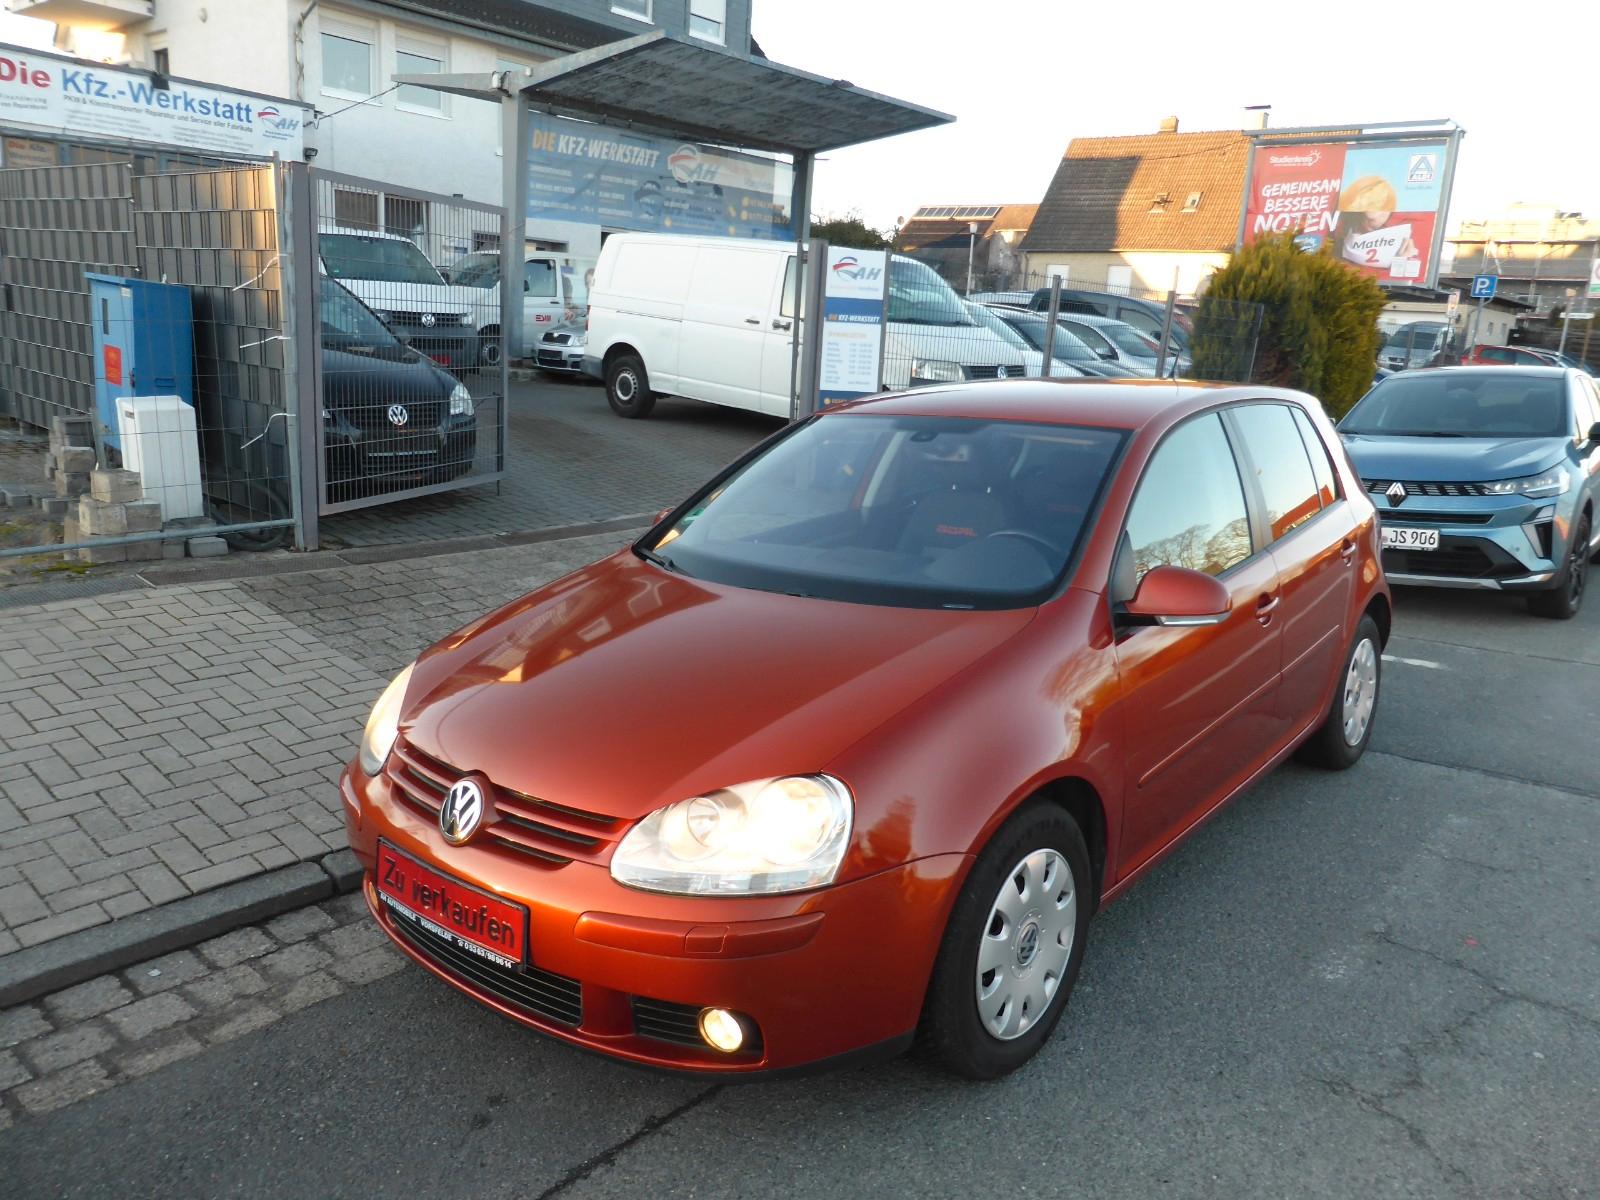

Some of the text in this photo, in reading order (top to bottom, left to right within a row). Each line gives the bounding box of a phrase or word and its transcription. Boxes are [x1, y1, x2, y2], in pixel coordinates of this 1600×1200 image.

[0, 57, 51, 88] Die
[61, 68, 252, 124] Kfz.-Werkstatt
[275, 117, 299, 131] AH
[532, 128, 660, 169] DIE KFZ-WERKSTATT
[1262, 178, 1341, 198] GEMEINSAM
[1264, 194, 1330, 213] BESSERE
[1254, 210, 1341, 234] NOTEN
[1353, 236, 1396, 250] Mathe
[1365, 249, 1380, 264] 2
[855, 266, 882, 281] AH
[1475, 278, 1490, 294] P
[1390, 530, 1436, 546] JS 906
[383, 856, 516, 949] Zu verkaufen
